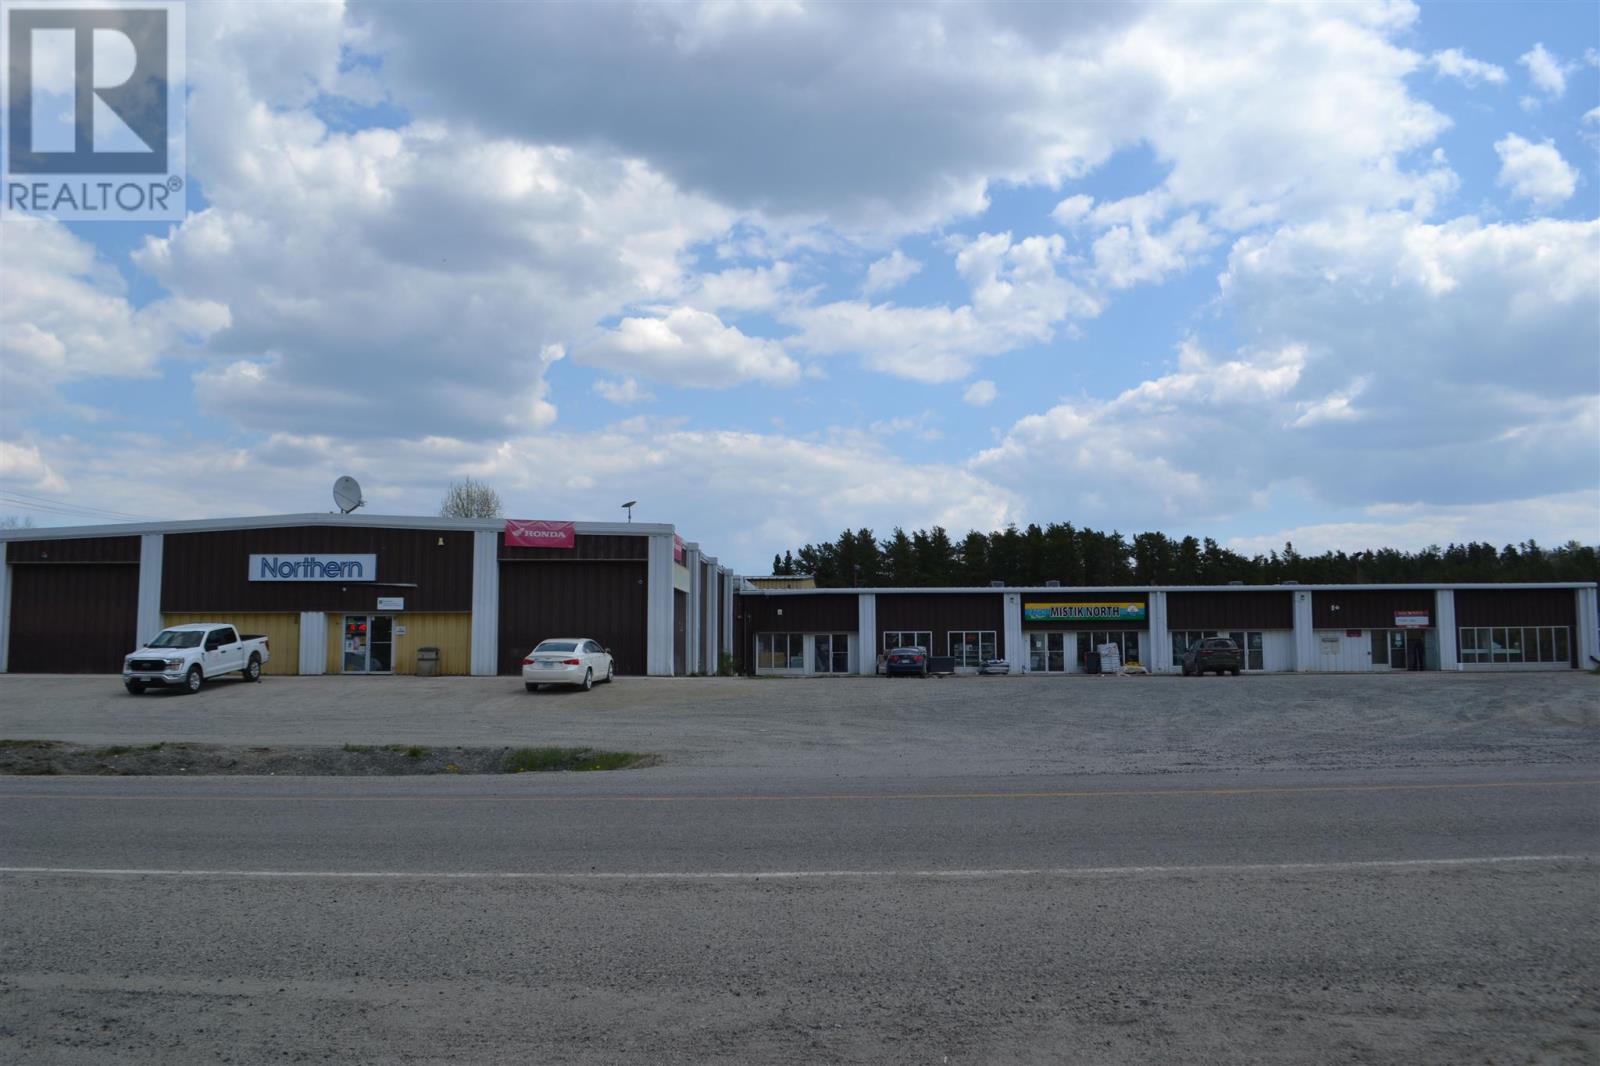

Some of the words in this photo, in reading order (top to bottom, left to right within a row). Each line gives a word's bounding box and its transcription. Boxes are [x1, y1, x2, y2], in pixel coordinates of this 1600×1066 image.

[524, 530, 566, 538] HONDA
[261, 557, 363, 578] Northern
[1050, 606, 1084, 617] MISTIK
[1086, 606, 1120, 617] NORTH
